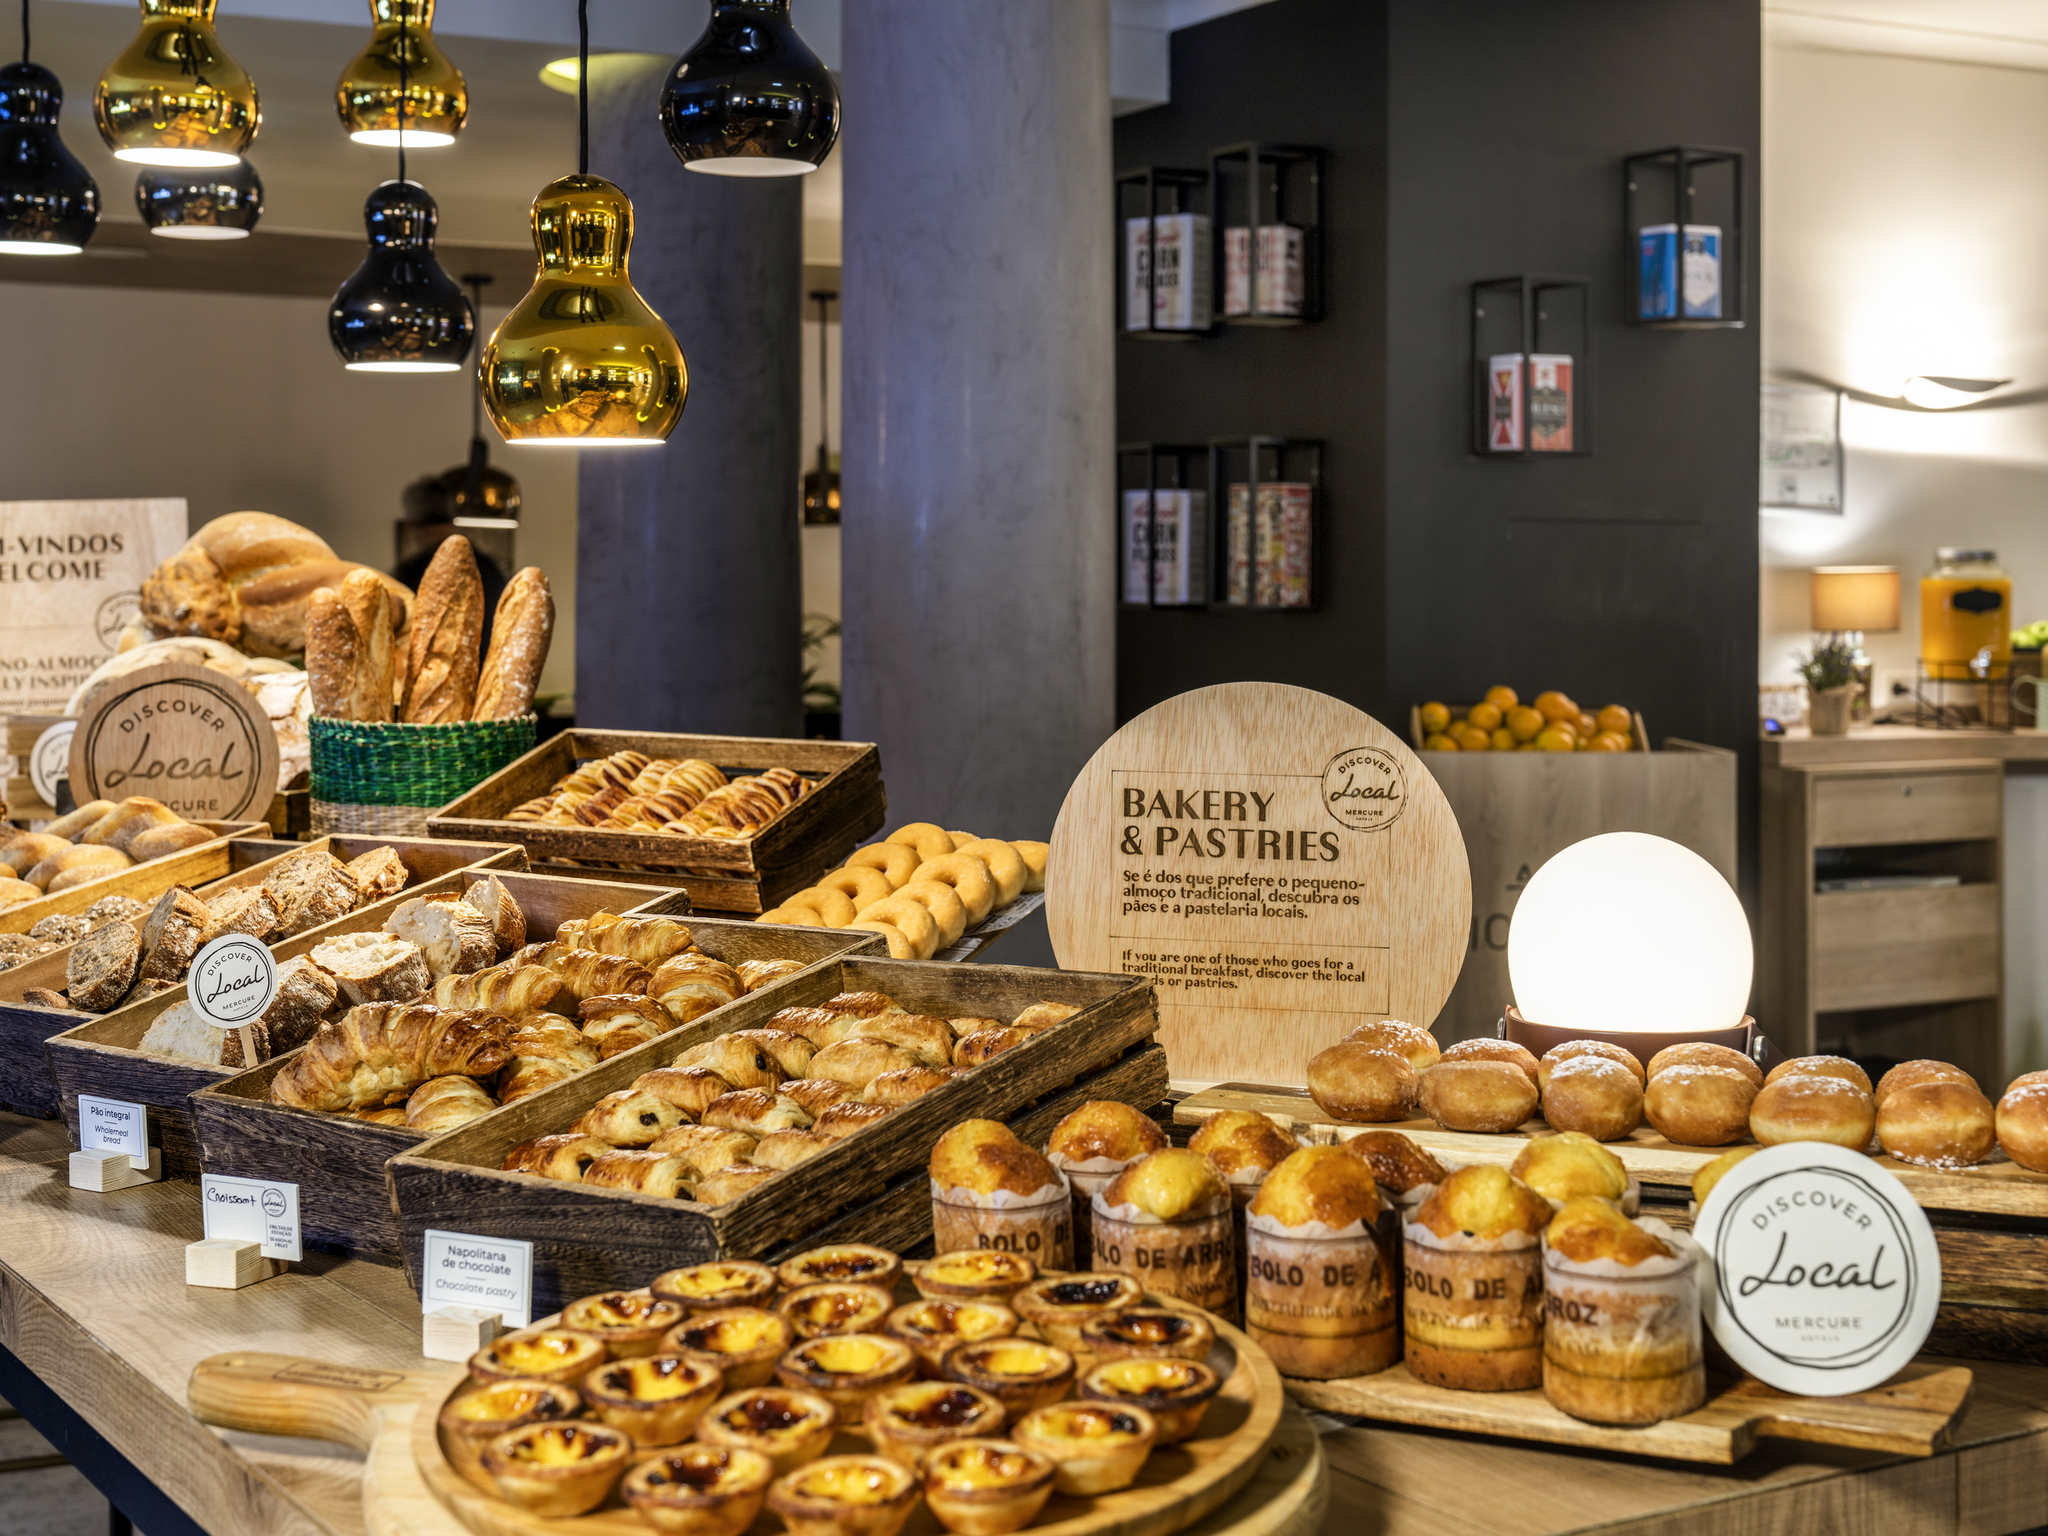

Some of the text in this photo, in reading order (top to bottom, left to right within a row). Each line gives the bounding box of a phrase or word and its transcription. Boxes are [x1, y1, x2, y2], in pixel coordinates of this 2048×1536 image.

[120, 699, 225, 733] DISCOVER
[104, 732, 244, 788] Local
[1338, 757, 1391, 775] DISCOVER
[1330, 773, 1400, 802] Local
[1123, 788, 1275, 822] BAKERY
[1345, 809, 1384, 817] MERCURE
[1120, 825, 1340, 862] & PASTRIES
[1123, 869, 1365, 893] Se é dos que prefere o pequeno-
[1123, 883, 1360, 905] almoço tradicional, descubra os
[1123, 900, 1308, 919] pães e a pastelaria locais.
[207, 953, 252, 976] DISCOVER
[1123, 949, 1354, 970] If you are one of those who goes for a
[207, 964, 265, 1003] Local
[1122, 963, 1365, 982] traditional breakfast, discover the local
[1168, 978, 1181, 986] or
[1185, 977, 1238, 990] pastries.
[222, 995, 256, 1010] MERCURE
[91, 1106, 131, 1121] Pão integral
[95, 1124, 129, 1137] Wholemeal
[103, 1136, 121, 1145] bread
[1752, 1191, 1873, 1231] DISCOVER
[448, 1245, 507, 1262] Napolitana
[1135, 1247, 1166, 1269] DE
[1739, 1231, 1896, 1296] Local
[442, 1258, 511, 1275] de chocolate
[1251, 1255, 1304, 1287] BOLO
[1323, 1264, 1355, 1287] DE
[436, 1278, 517, 1300] Chocolate pastry
[1473, 1278, 1505, 1300] DE
[1776, 1316, 1862, 1329] MERCURE
